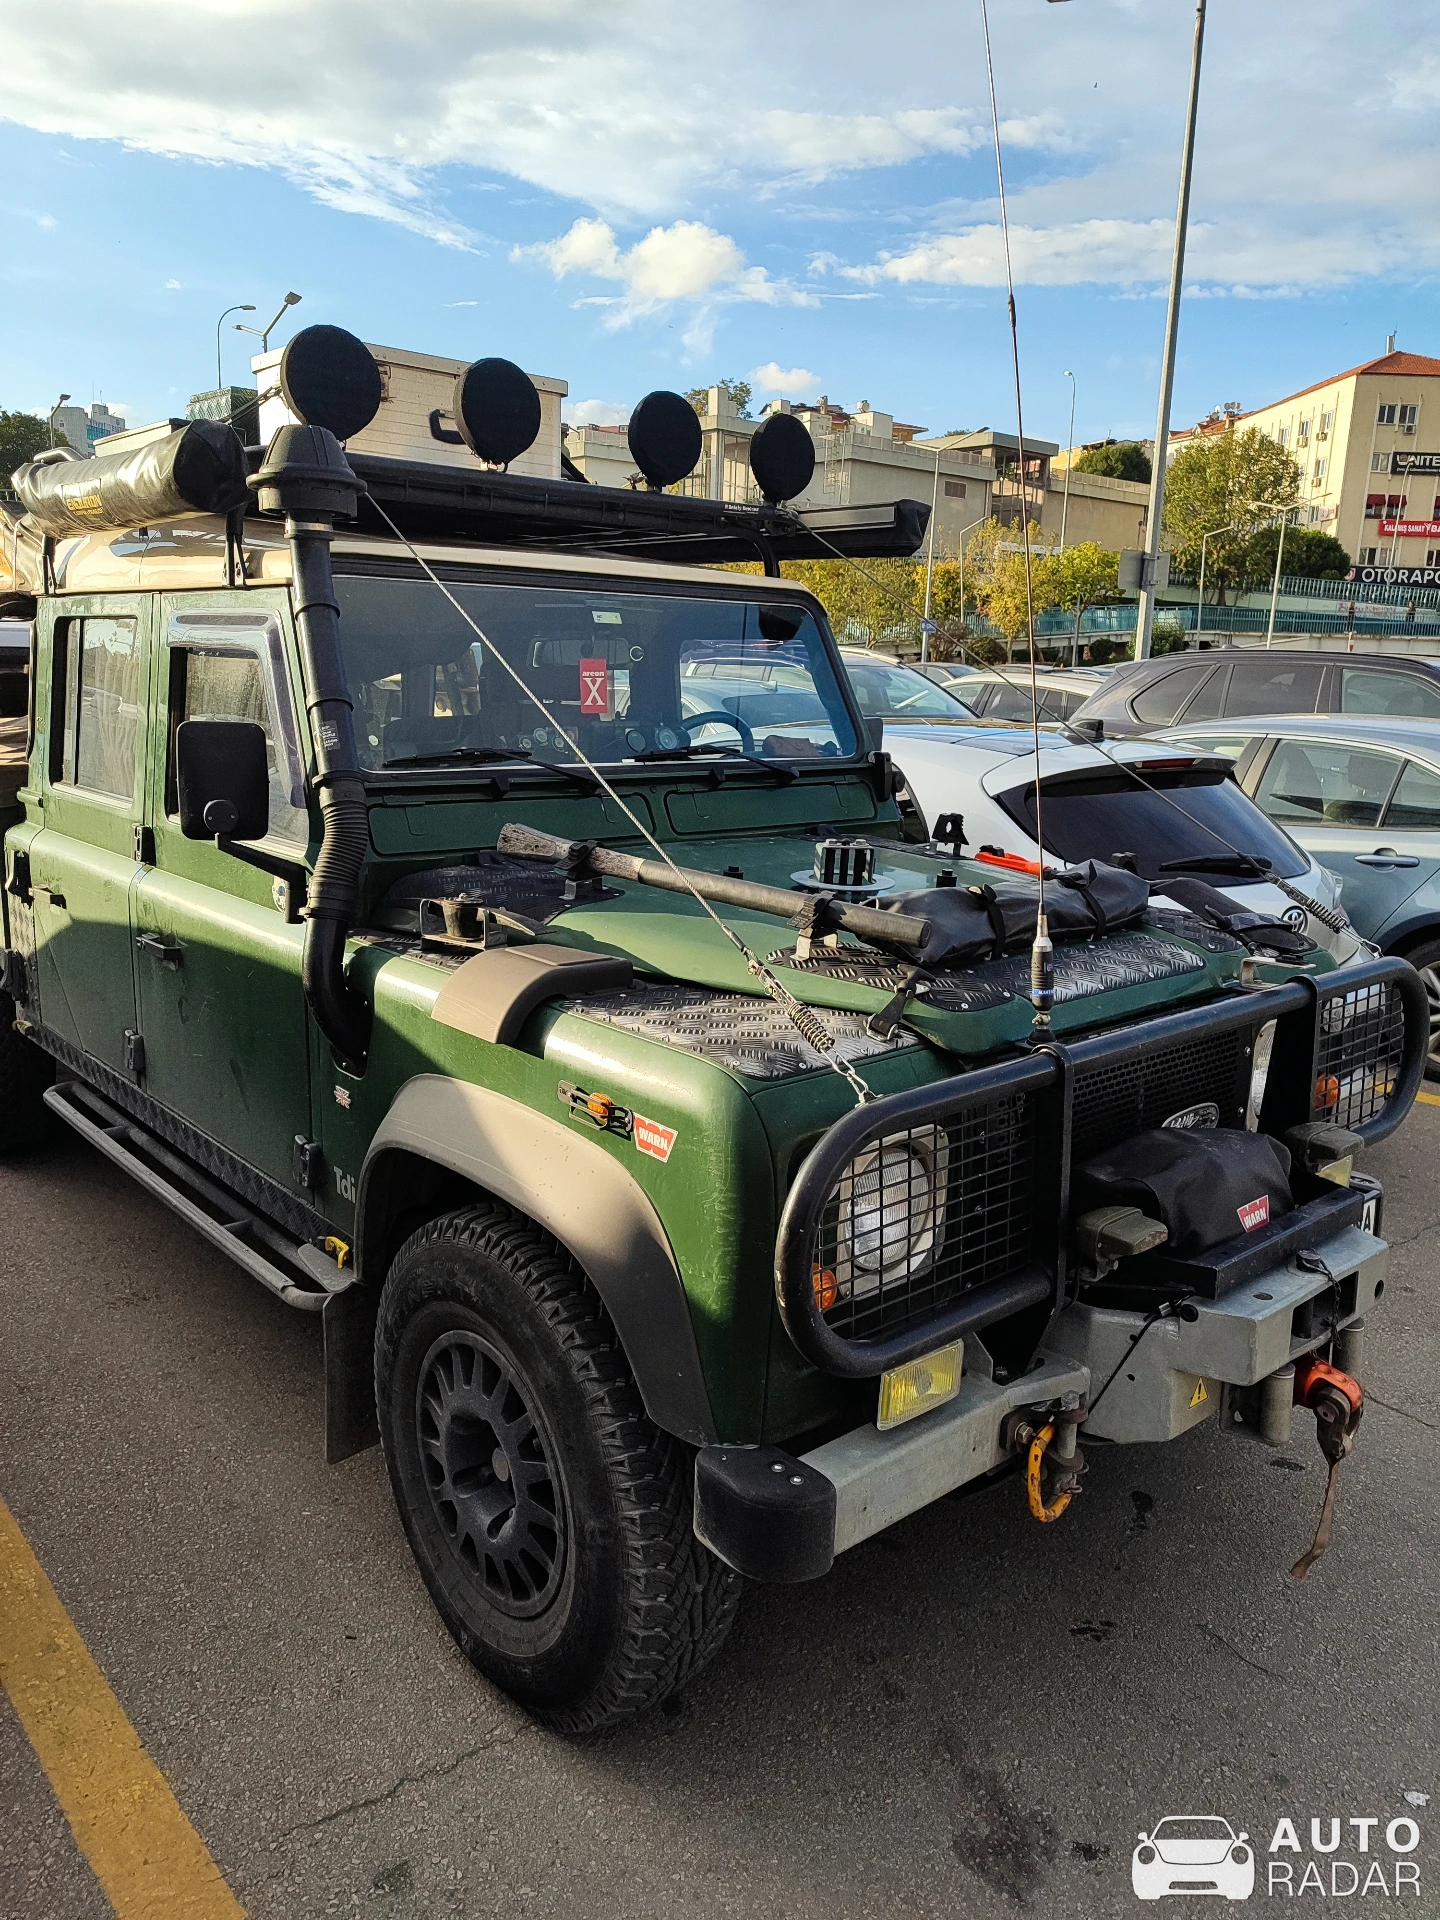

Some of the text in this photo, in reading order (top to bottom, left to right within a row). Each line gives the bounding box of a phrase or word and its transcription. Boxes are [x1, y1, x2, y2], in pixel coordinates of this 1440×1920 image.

[1384, 524, 1407, 533] KALMIŞ
[582, 677, 606, 706] X
[638, 1126, 669, 1151] WARN
[333, 1165, 356, 1204] Tdi
[1243, 1206, 1267, 1229] WARN
